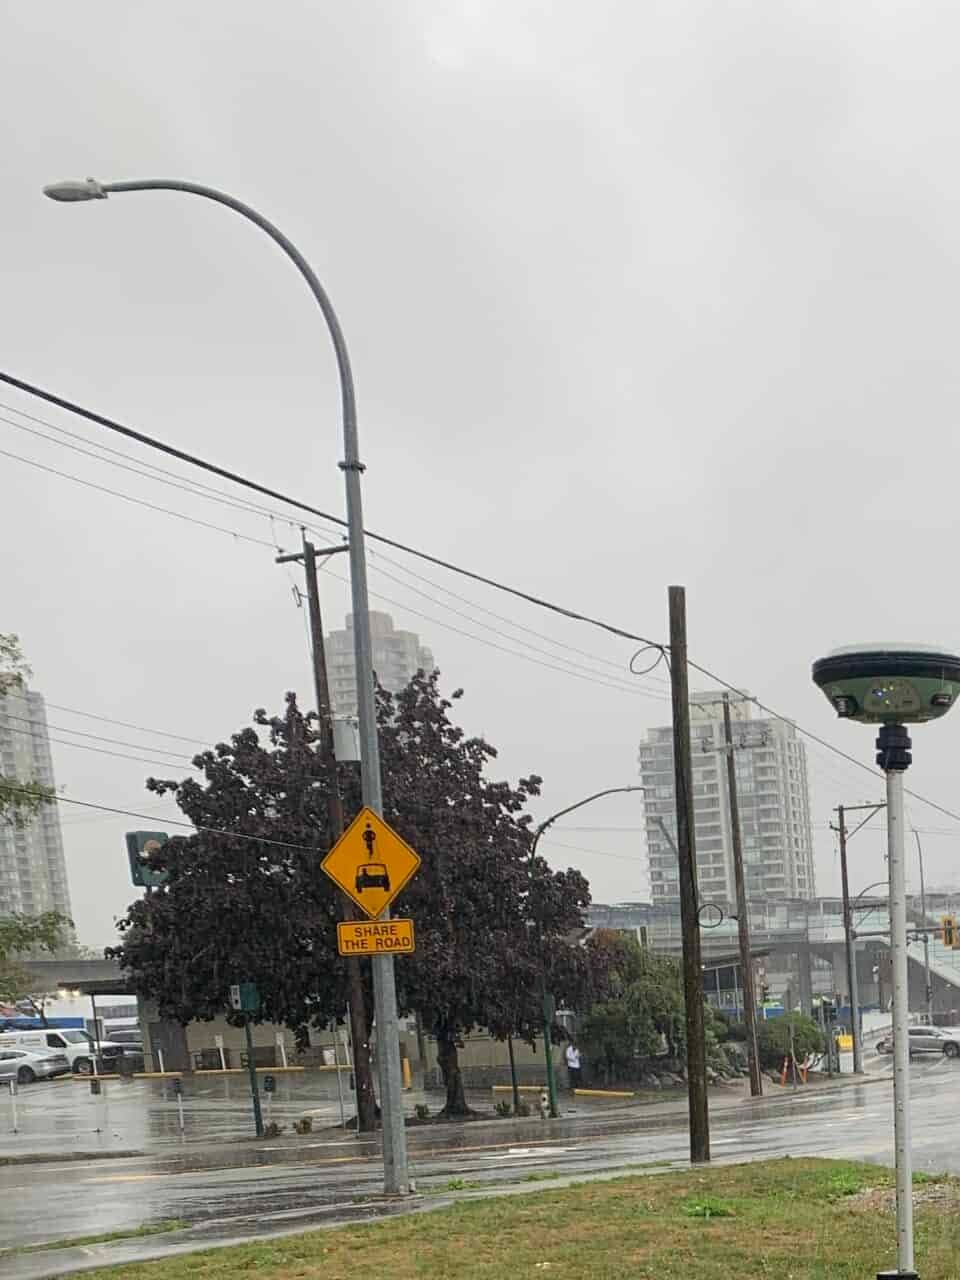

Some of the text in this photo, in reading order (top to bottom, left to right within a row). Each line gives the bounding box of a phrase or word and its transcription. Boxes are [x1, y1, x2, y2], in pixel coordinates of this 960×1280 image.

[354, 925, 398, 937] SHARE
[344, 936, 410, 950] THE ROAD
